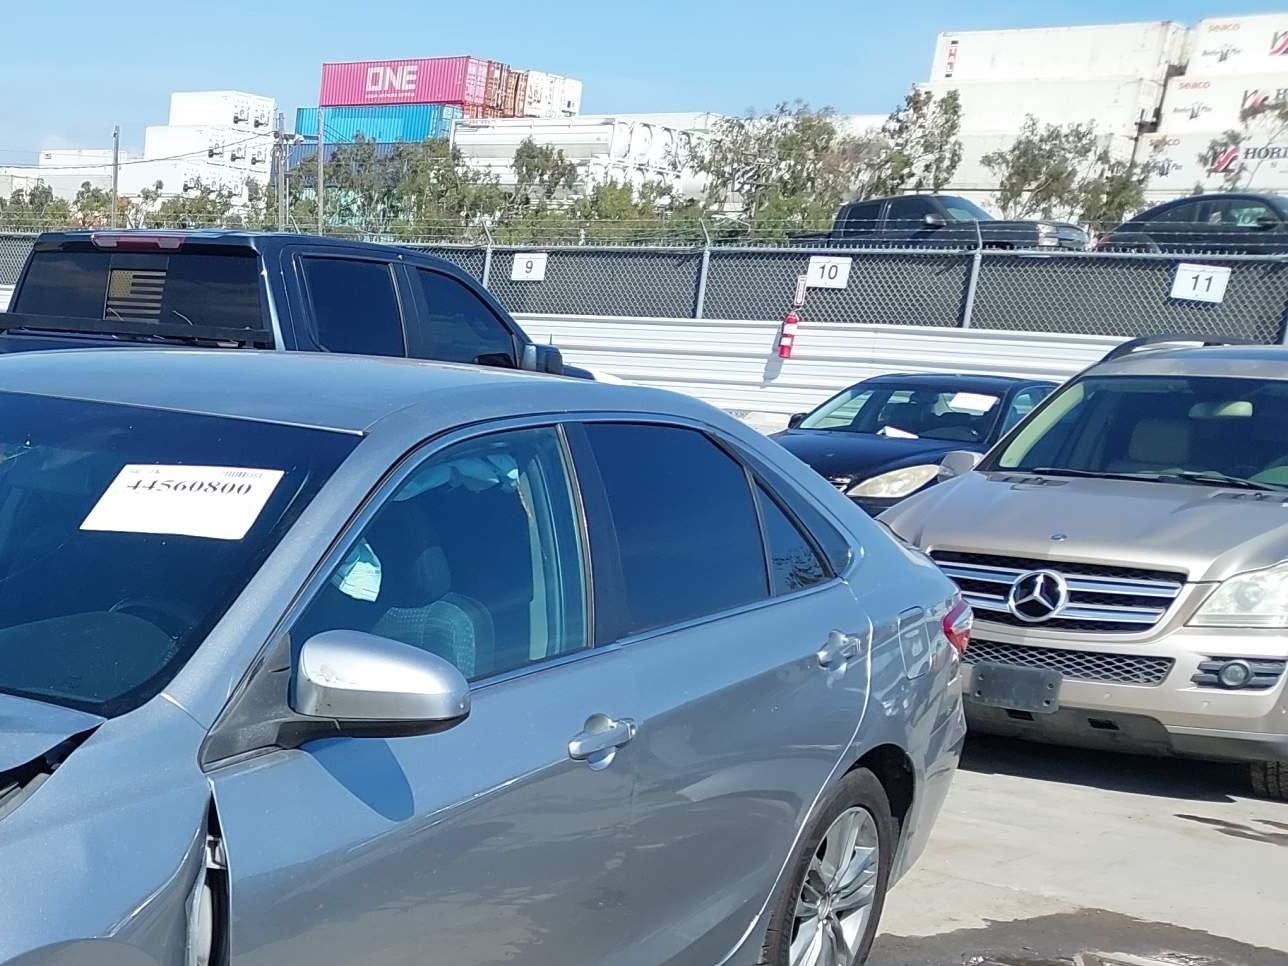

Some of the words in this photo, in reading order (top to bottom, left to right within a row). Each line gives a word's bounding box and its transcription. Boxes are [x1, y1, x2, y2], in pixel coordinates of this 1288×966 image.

[365, 65, 418, 92] ONE
[524, 260, 534, 274] 9
[818, 264, 839, 280] 10
[1191, 274, 1214, 293] 11
[127, 478, 252, 495] 44560800
